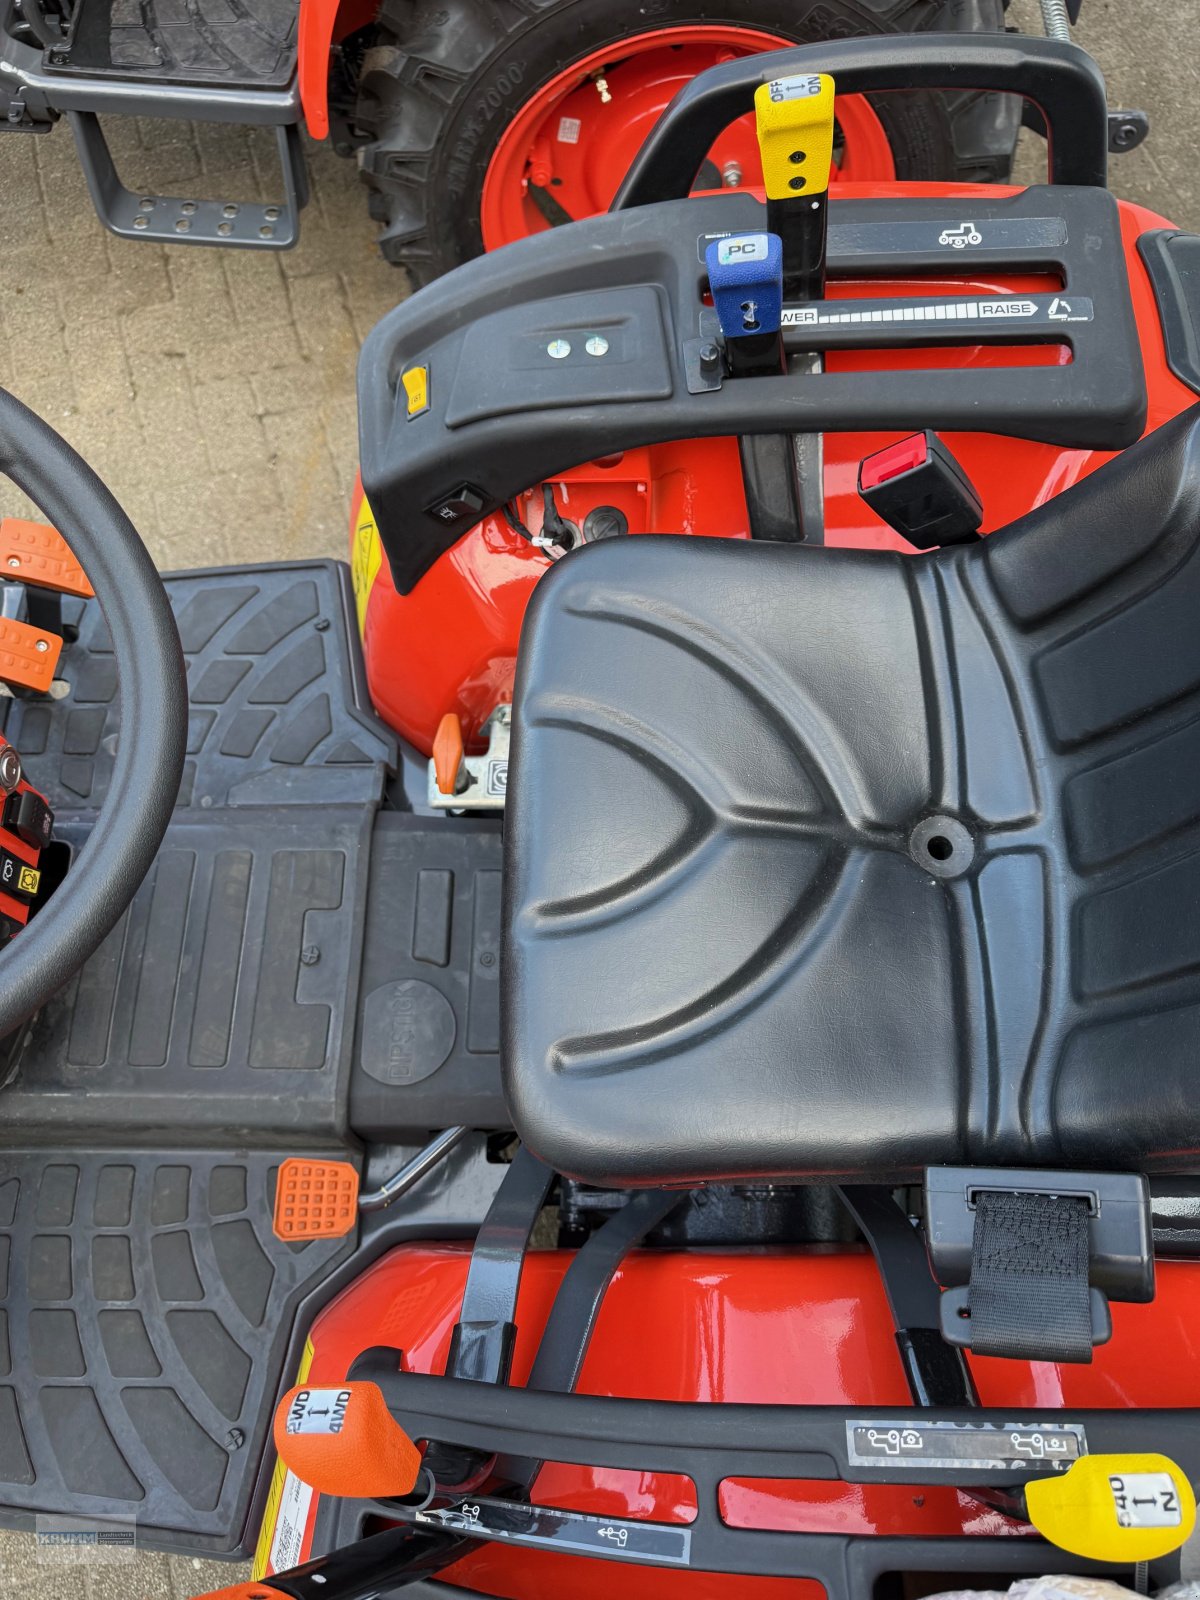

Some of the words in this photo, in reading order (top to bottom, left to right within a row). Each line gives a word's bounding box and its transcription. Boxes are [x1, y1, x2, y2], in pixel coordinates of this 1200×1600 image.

[770, 82, 785, 102] OFF
[807, 76, 821, 94] ON
[728, 243, 756, 256] PC
[781, 312, 815, 322] WER
[982, 304, 1031, 315] RAISE
[388, 986, 417, 1079] DIPSTICK
[287, 1391, 311, 1434] 2WD
[328, 1391, 352, 1433] 4WD
[1159, 1491, 1178, 1512] N
